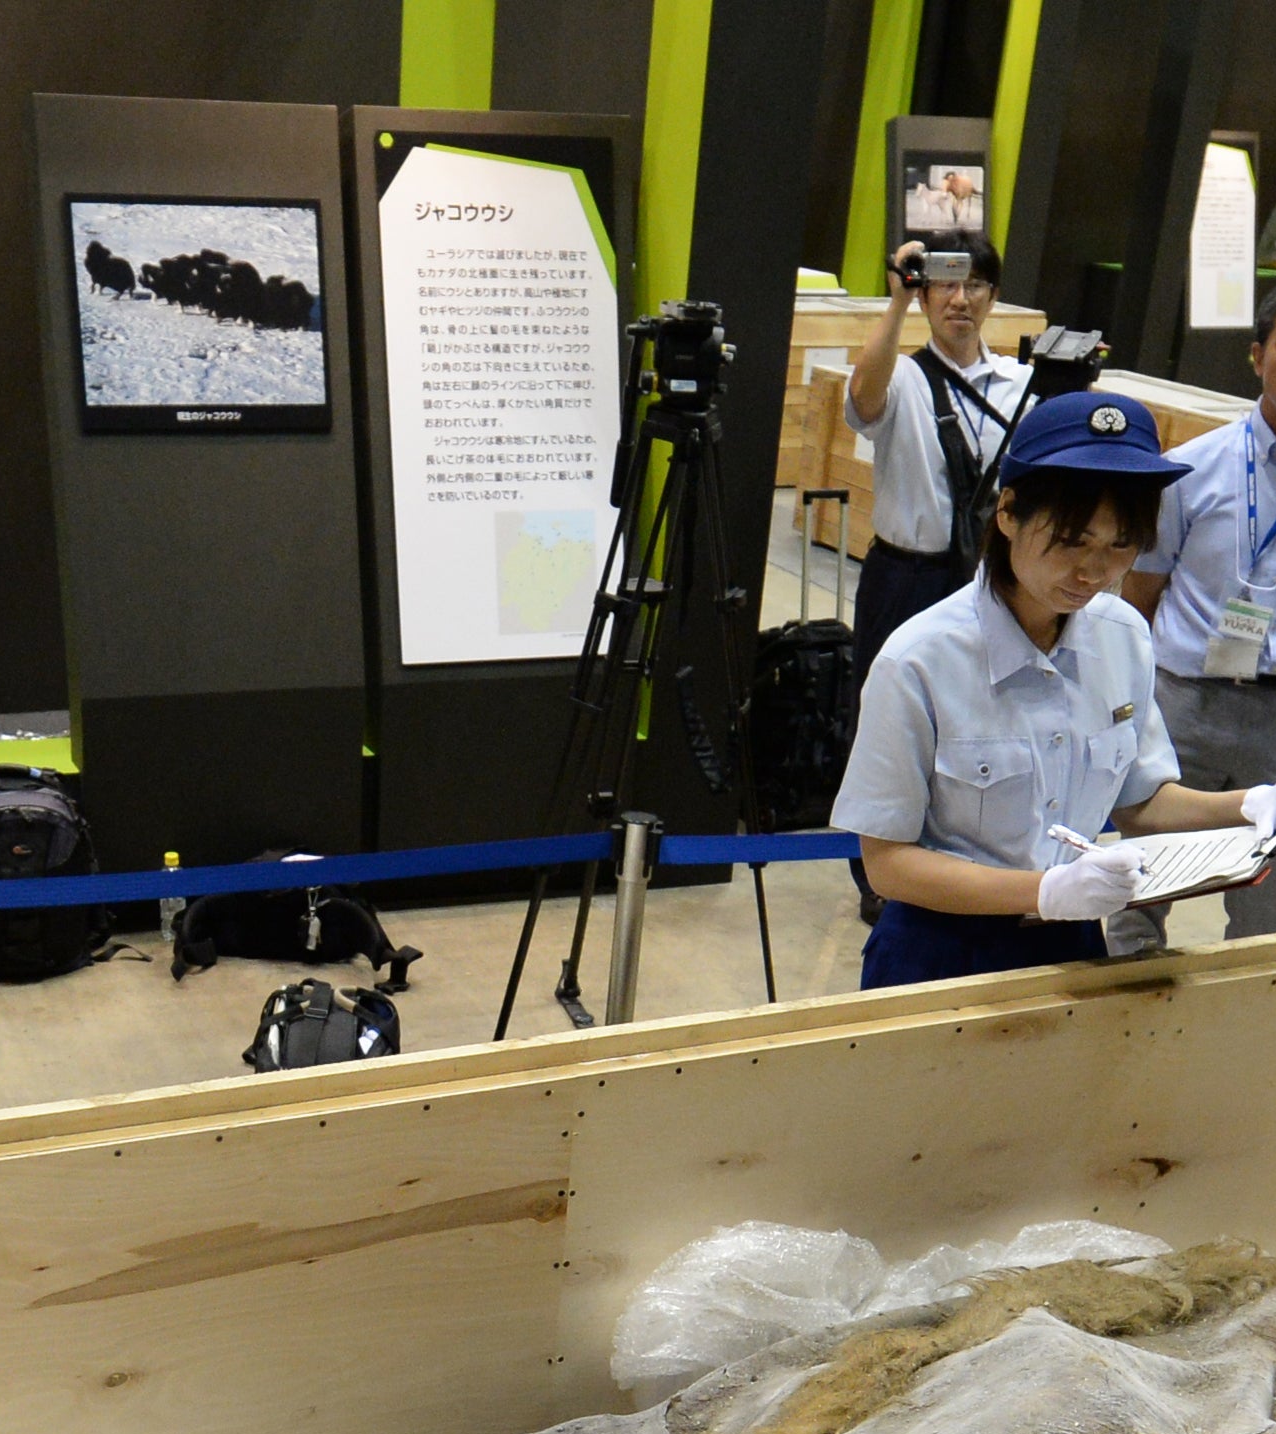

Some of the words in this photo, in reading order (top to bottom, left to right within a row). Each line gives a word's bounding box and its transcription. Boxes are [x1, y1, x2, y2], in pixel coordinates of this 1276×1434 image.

[415, 202, 514, 223] ジャコウウシ
[424, 417, 504, 429] おおわれています。
[427, 489, 524, 502] さを防いでいるのです。
